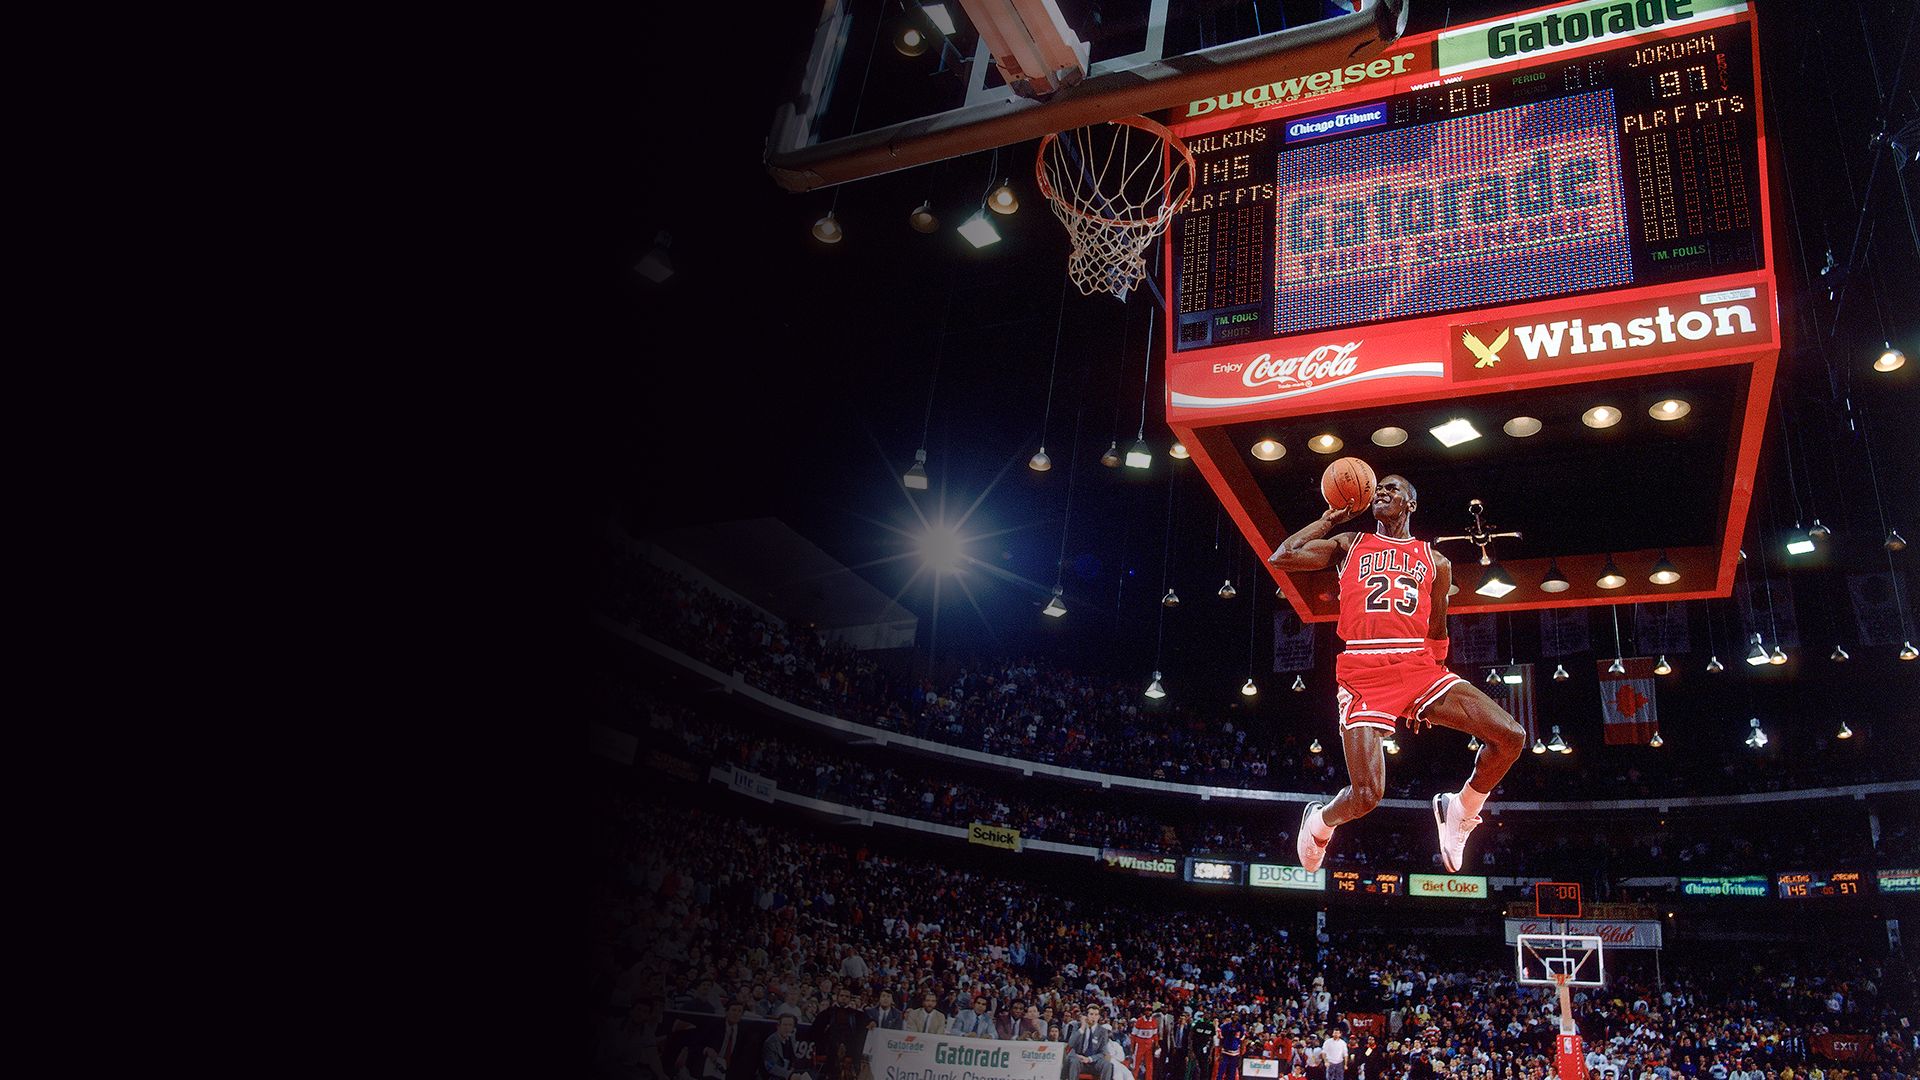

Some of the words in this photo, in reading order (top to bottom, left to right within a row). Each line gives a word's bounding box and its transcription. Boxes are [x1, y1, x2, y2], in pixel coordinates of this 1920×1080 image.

[1488, 0, 1694, 59] Gatorade
[1628, 35, 1716, 68] JORDAN
[1410, 79, 1441, 92] WHITE
[1443, 75, 1464, 86] WAY
[1512, 72, 1546, 85] PERIOD
[1624, 109, 1668, 133] PLR
[1674, 105, 1687, 123] F
[1695, 95, 1744, 119] PTS
[1290, 119, 1334, 137] Chicago
[1335, 109, 1382, 129] Tribune
[1188, 126, 1266, 154] WILKINS
[1203, 154, 1250, 185] 145
[1219, 190, 1230, 207] F
[1236, 183, 1274, 204] PTS
[1287, 150, 1601, 254] Gatorade
[1672, 244, 1706, 258] FOULS
[1231, 311, 1259, 324] FOULS
[1514, 304, 1757, 361] Winston
[1213, 361, 1244, 374] Enjoy
[1358, 549, 1428, 584] BULLS
[1365, 574, 1419, 617] 23
[973, 827, 1015, 844] Schick
[1118, 856, 1176, 874] Winston
[1258, 866, 1318, 884] BUSCH
[1338, 880, 1355, 891] 145
[1381, 882, 1395, 894] 97
[1422, 879, 1444, 892] diet
[1447, 879, 1479, 893] Coke
[1685, 883, 1721, 895] Chicago
[1721, 882, 1766, 897] Tribune
[1787, 884, 1807, 896] 145
[1840, 882, 1857, 895] 97
[1597, 924, 1636, 943] Club
[887, 1039, 925, 1052] Gatorade
[1833, 1041, 1859, 1052] EXIT
[934, 1042, 1010, 1069] Gatorade
[1021, 1049, 1057, 1061] Gatorade
